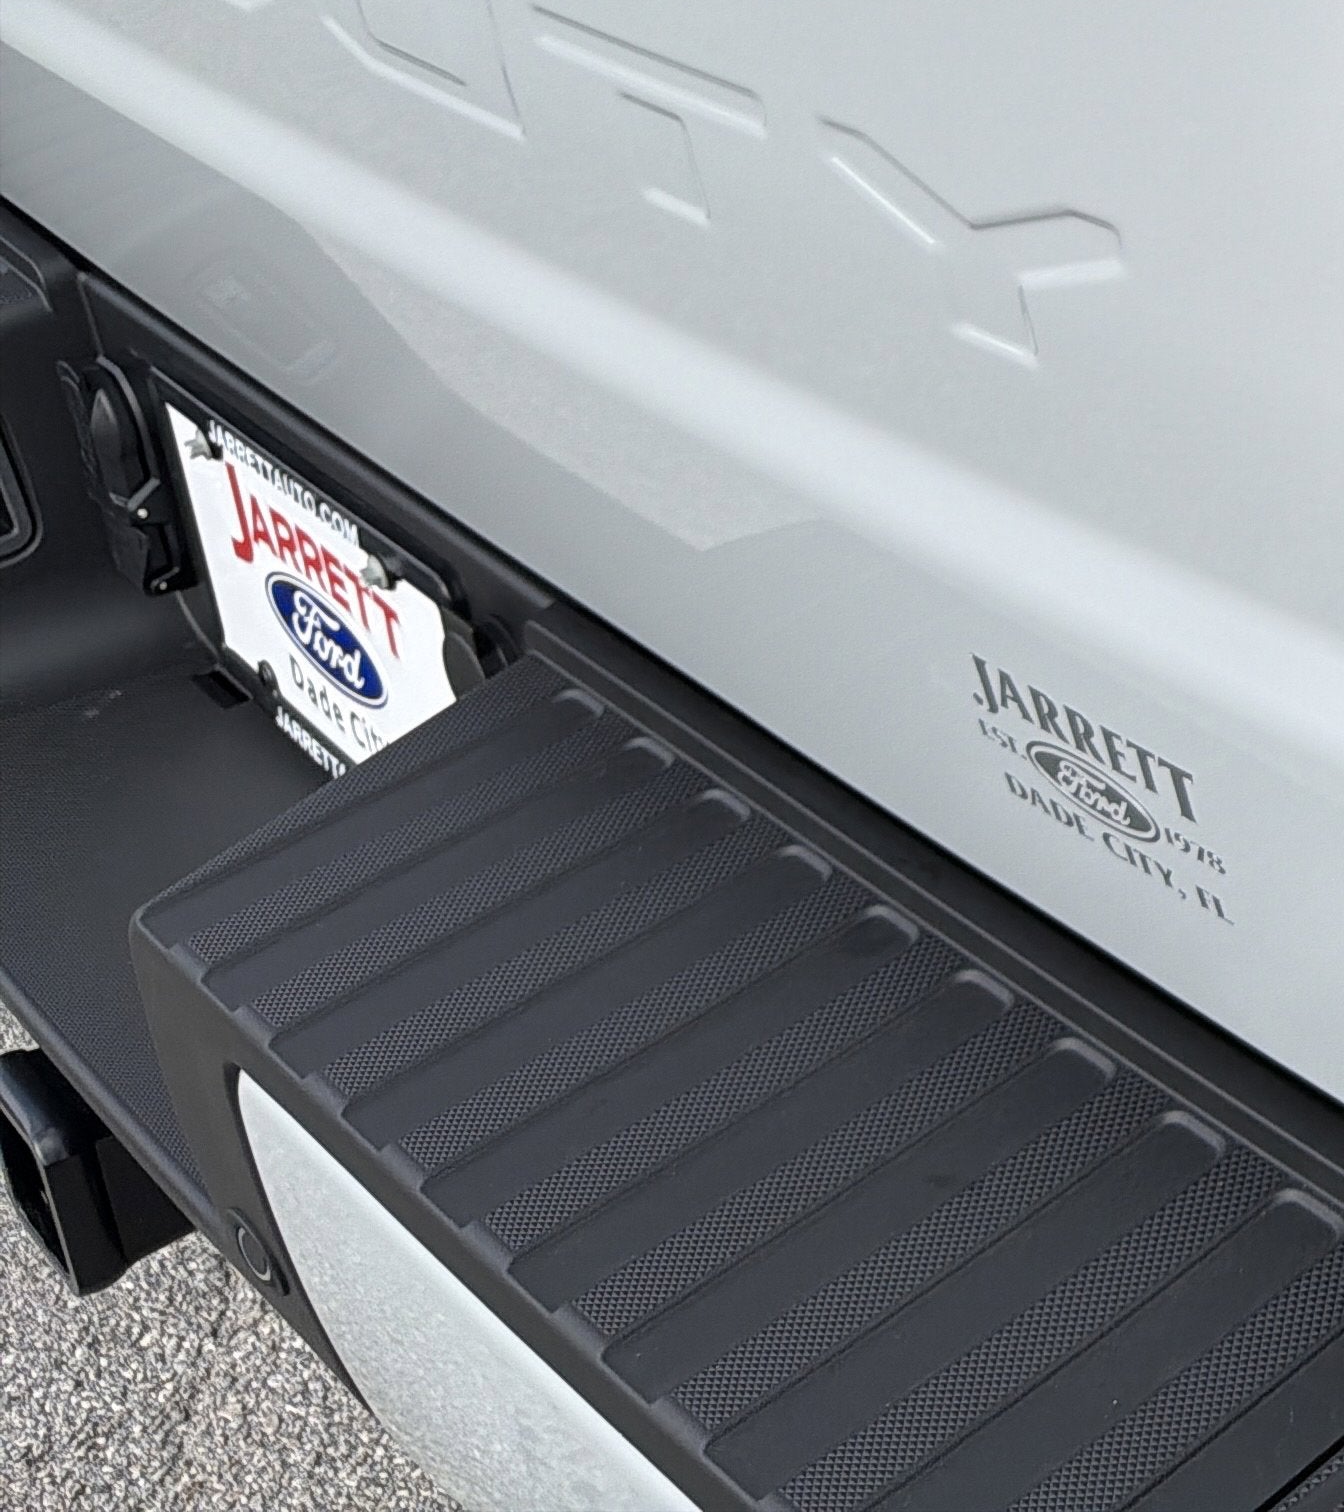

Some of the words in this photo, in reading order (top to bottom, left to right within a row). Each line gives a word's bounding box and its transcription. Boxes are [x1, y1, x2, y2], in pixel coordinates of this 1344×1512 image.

[207, 419, 360, 548] JARRETTAUTO.COM
[225, 462, 401, 659] JARRETT
[289, 653, 346, 734] Dade
[350, 711, 391, 752] Cit
[292, 590, 366, 690] Ford
[970, 652, 1197, 822] JARRETT
[1004, 772, 1095, 842] DADE
[1102, 832, 1188, 900] CITY,
[1195, 885, 1235, 926] FL
[1056, 760, 1132, 828] Ford
[1163, 827, 1227, 875] 1978
